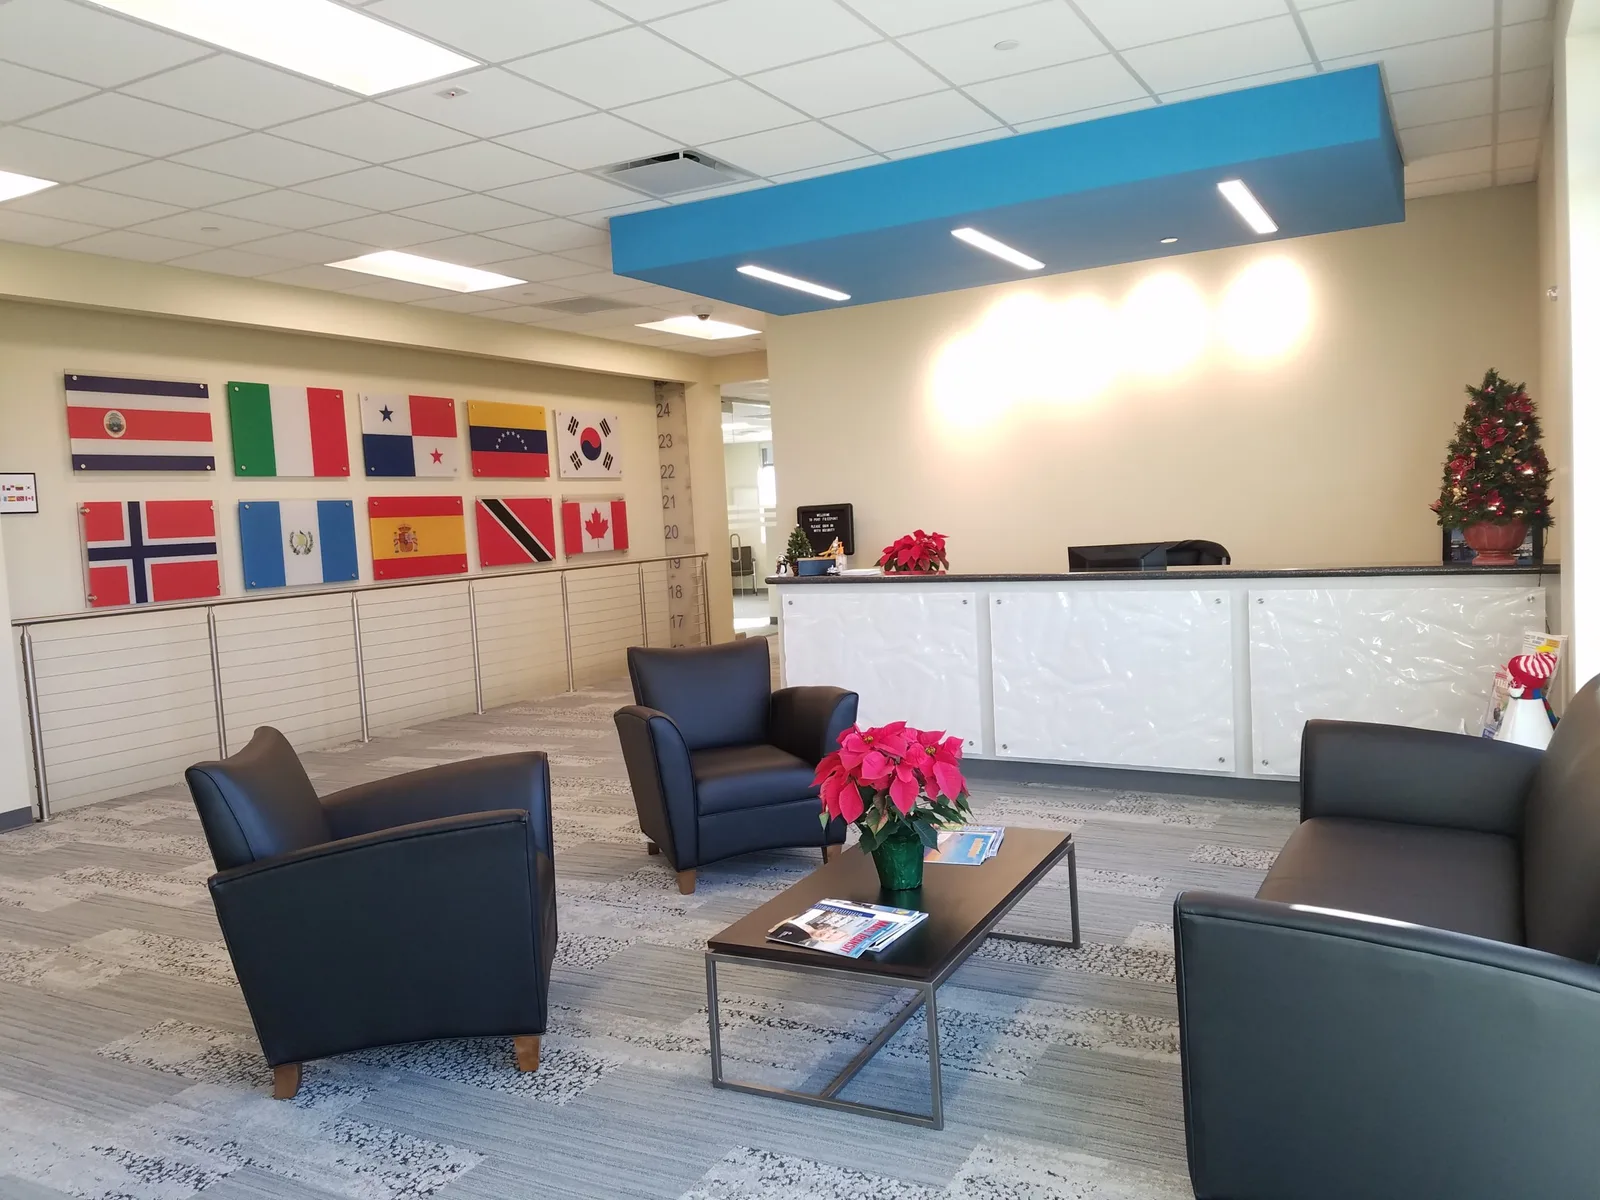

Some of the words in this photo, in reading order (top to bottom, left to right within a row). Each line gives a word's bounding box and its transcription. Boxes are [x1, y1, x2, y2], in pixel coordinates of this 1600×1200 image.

[656, 403, 670, 418] 24
[658, 433, 673, 448] 23
[660, 464, 675, 479] 22
[662, 494, 676, 509] 21
[664, 524, 679, 539] 20
[668, 584, 683, 599] 18
[670, 614, 684, 629] 17
